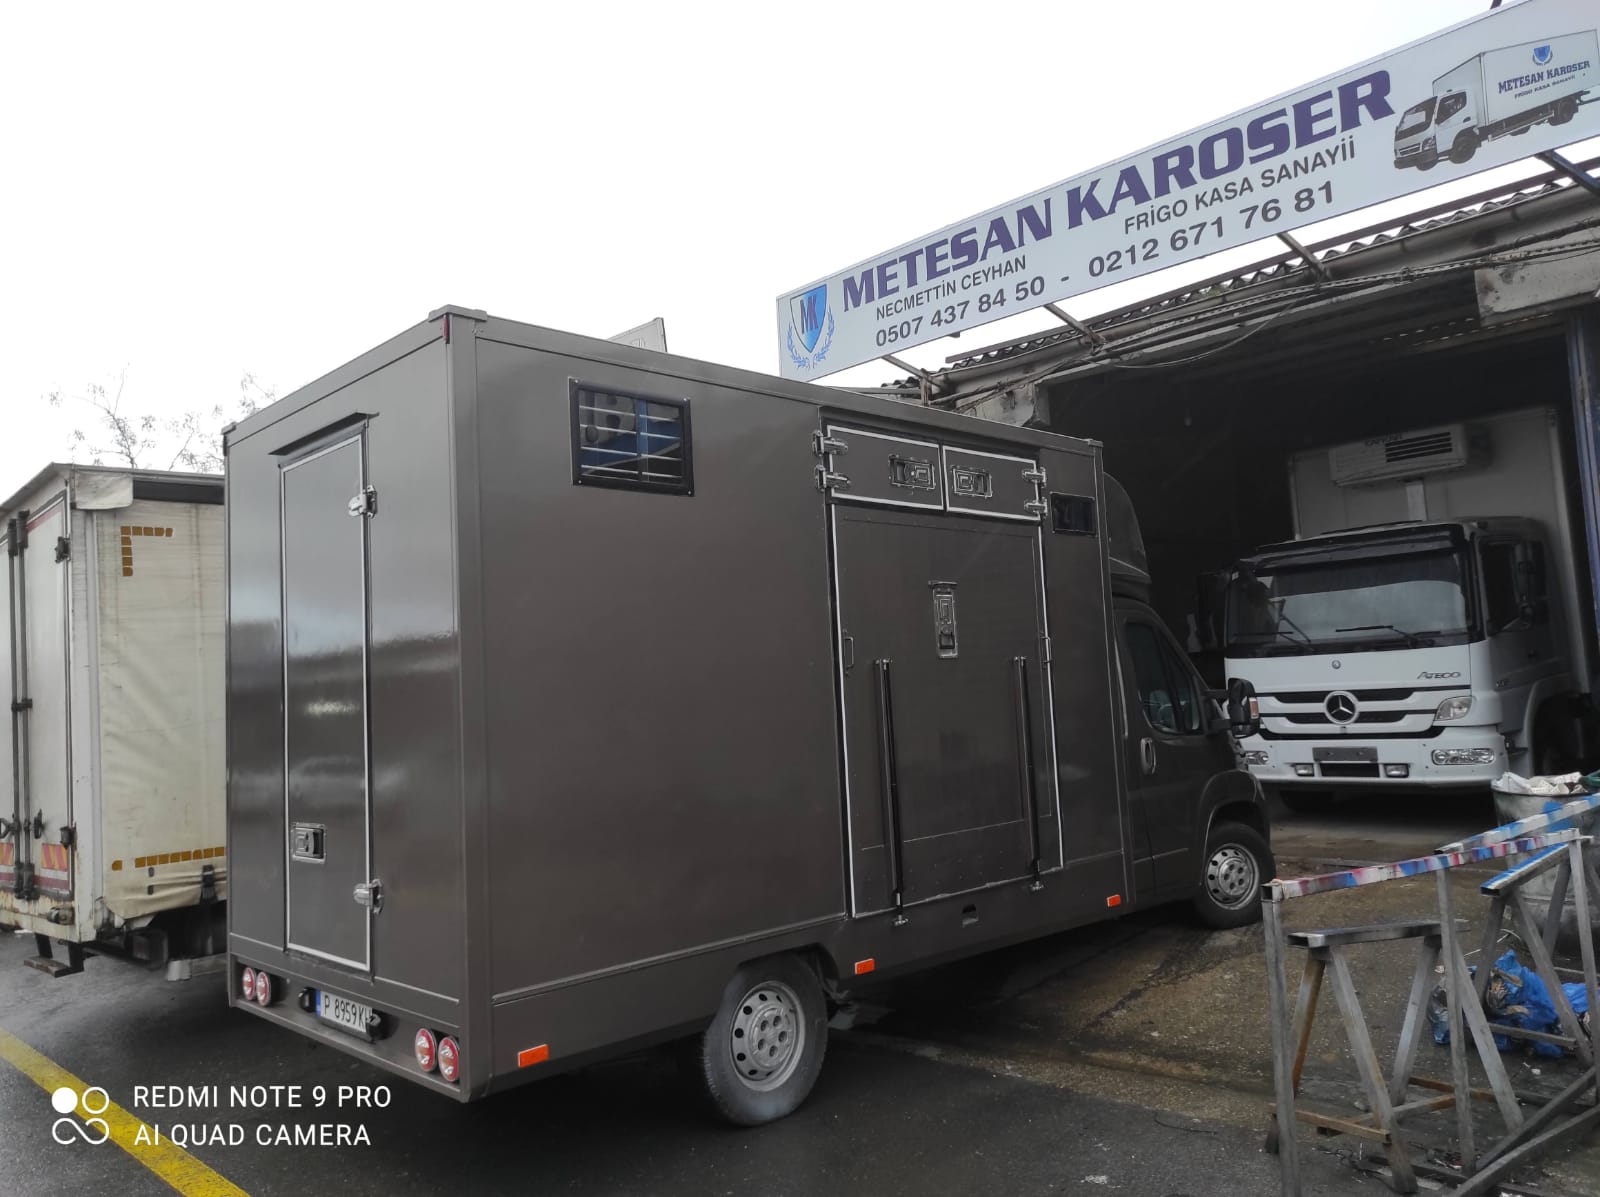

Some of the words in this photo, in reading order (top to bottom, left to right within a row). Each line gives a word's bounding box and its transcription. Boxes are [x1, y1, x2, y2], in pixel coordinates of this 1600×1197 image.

[1498, 72, 1544, 94] METESAN
[1547, 61, 1590, 79] KAROSER
[842, 198, 1053, 313] METESAN
[1066, 70, 1396, 229] KAROSER
[1124, 199, 1188, 234] FRİGO
[1195, 176, 1254, 210] KASA
[1261, 135, 1355, 188] SANAYİİ
[876, 316, 924, 347] 0507
[930, 300, 970, 327] 437
[978, 288, 1007, 313] 84
[1015, 275, 1045, 301] 50
[1088, 238, 1160, 277] 0212
[1170, 216, 1223, 250] 671
[1239, 198, 1282, 229] 76
[1294, 181, 1333, 211] 81
[876, 280, 956, 320] NECMETTİN
[961, 254, 1026, 290] CEYHAN
[799, 293, 820, 335] MK
[324, 994, 330, 1017] P
